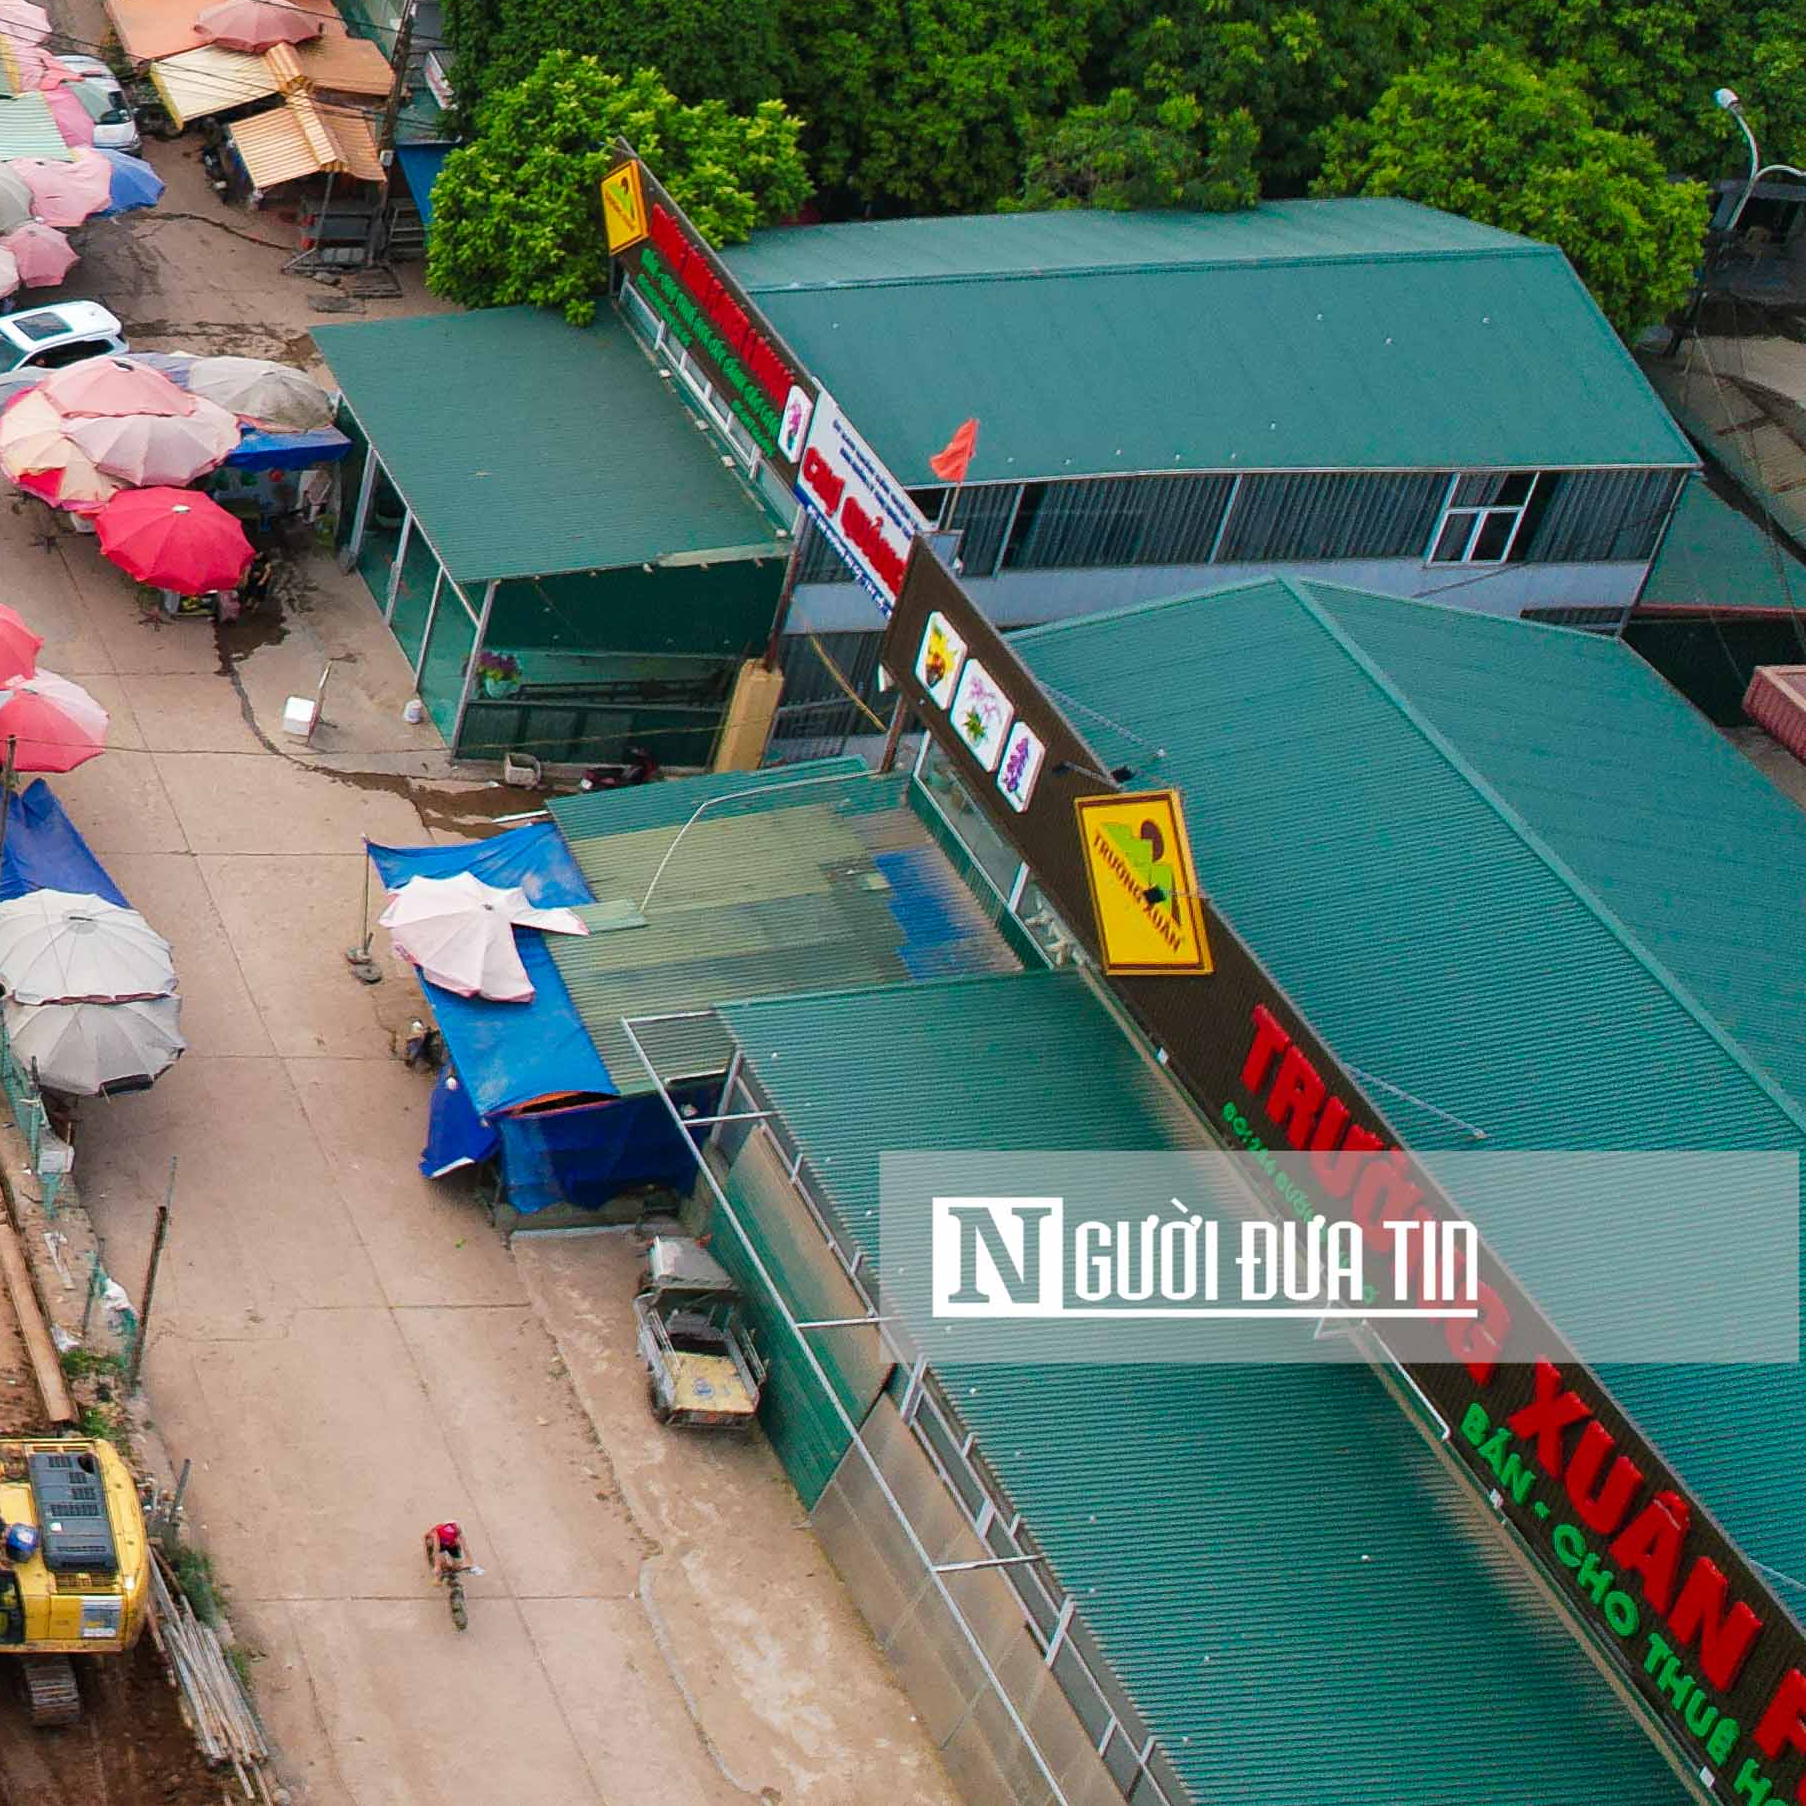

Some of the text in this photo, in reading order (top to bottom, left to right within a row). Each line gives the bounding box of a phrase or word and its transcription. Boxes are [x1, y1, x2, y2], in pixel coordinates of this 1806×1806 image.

[1239, 1002, 1513, 1388] TRƯỜNG
[1461, 1402, 1537, 1506] BÁN
[1552, 1523, 1640, 1637] CHO
[1507, 1355, 1763, 1692] XUÂN
